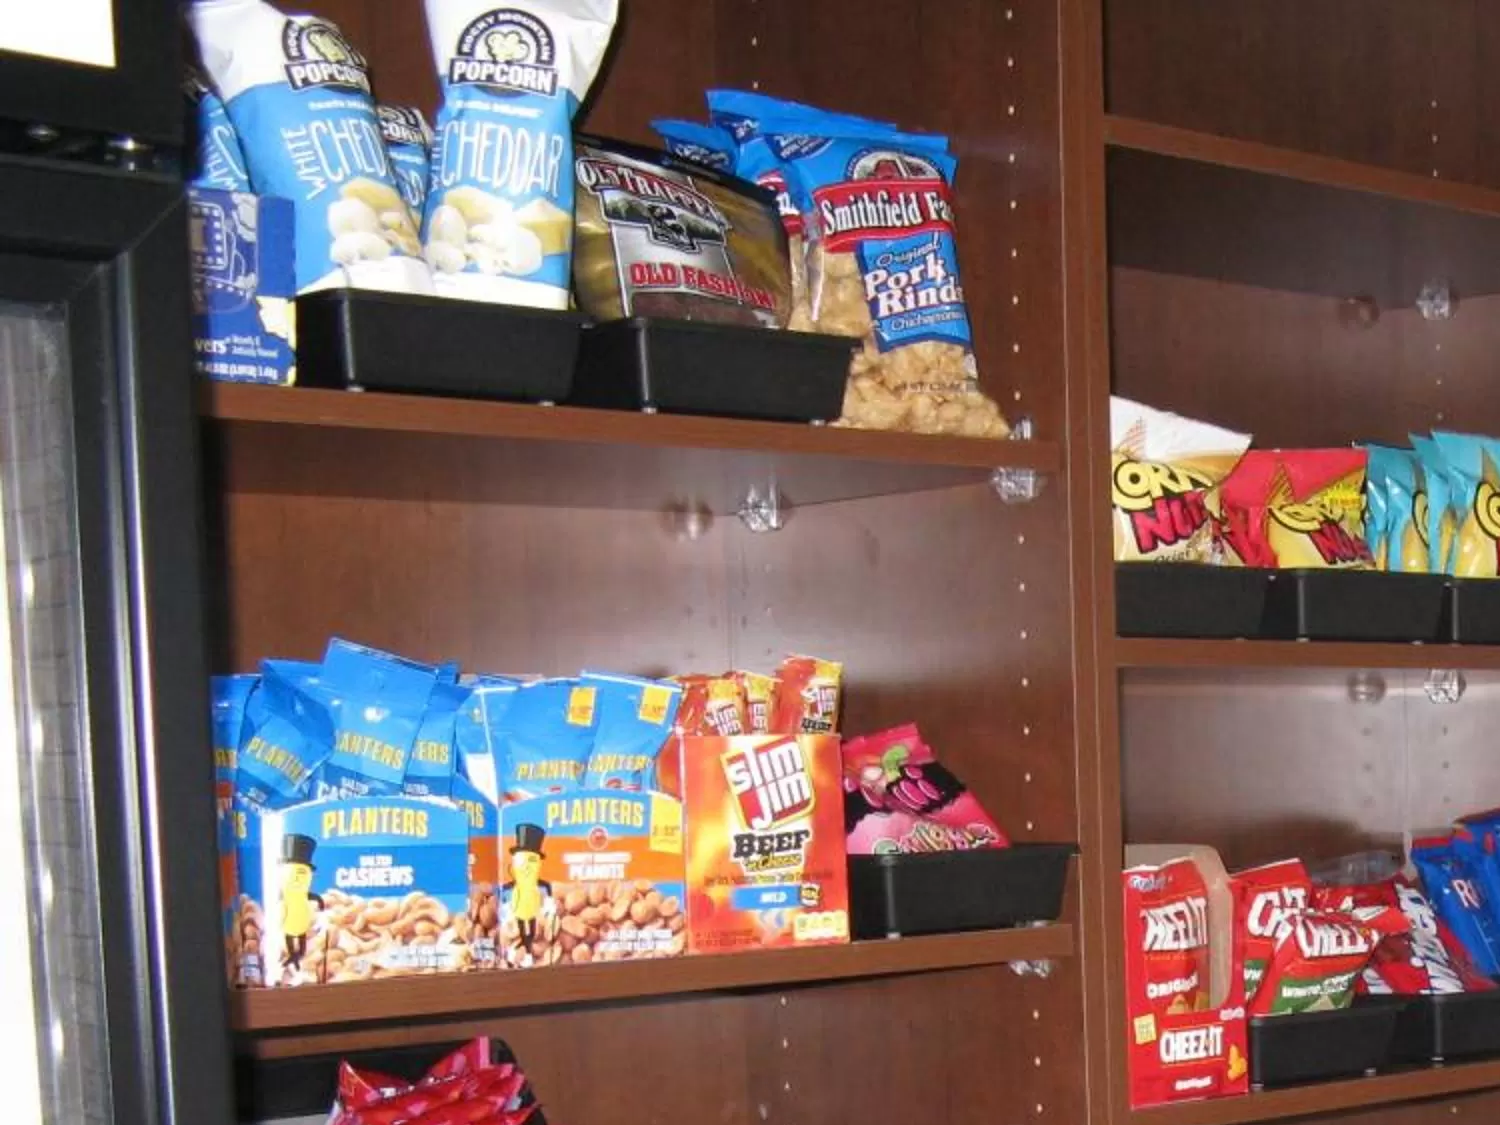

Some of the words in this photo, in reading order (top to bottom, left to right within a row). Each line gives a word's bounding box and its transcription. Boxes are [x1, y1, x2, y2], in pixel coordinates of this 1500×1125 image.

[452, 61, 555, 94] POPCORN
[311, 117, 386, 184] CHED
[441, 121, 565, 199] CHEDDAR
[820, 190, 923, 236] Smithfield
[630, 263, 677, 287] OLD
[864, 255, 946, 300] Pork
[322, 806, 429, 840] PLANTERS
[547, 798, 645, 829] PLANTERS
[733, 829, 811, 859] BEEF
[335, 865, 415, 888] CASHEWS
